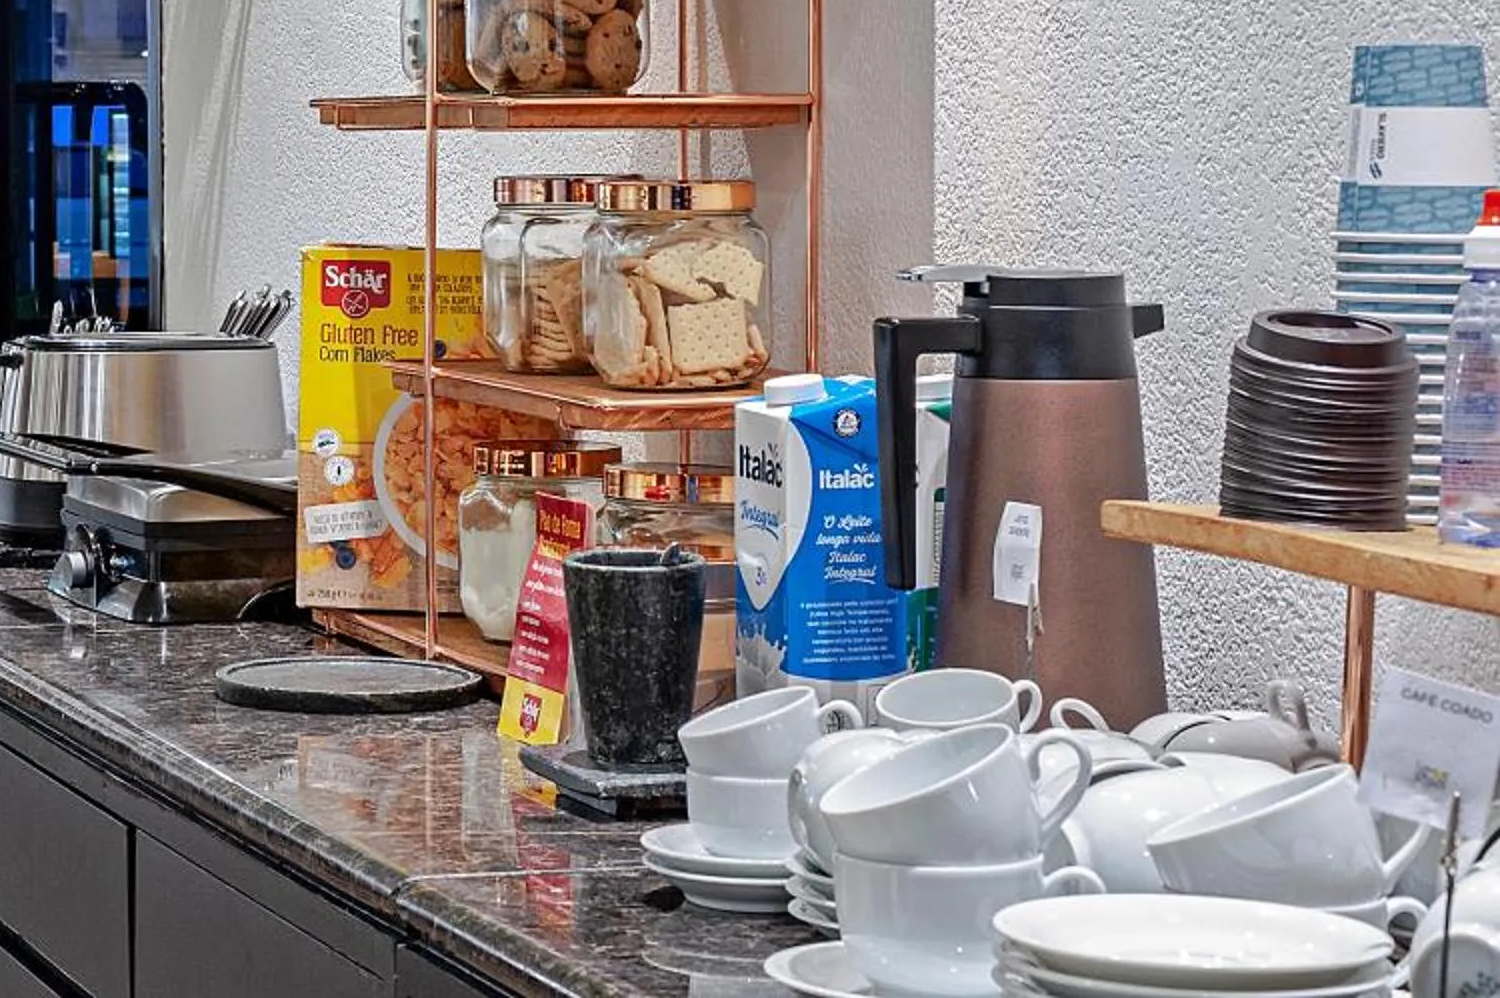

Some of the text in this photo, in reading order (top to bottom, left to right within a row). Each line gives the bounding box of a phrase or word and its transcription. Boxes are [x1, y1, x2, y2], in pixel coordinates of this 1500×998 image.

[325, 264, 387, 294] Schär
[320, 323, 418, 347] Gluten Free
[354, 346, 396, 363] Flakes
[739, 444, 783, 489] Italac
[819, 465, 875, 490] Italac
